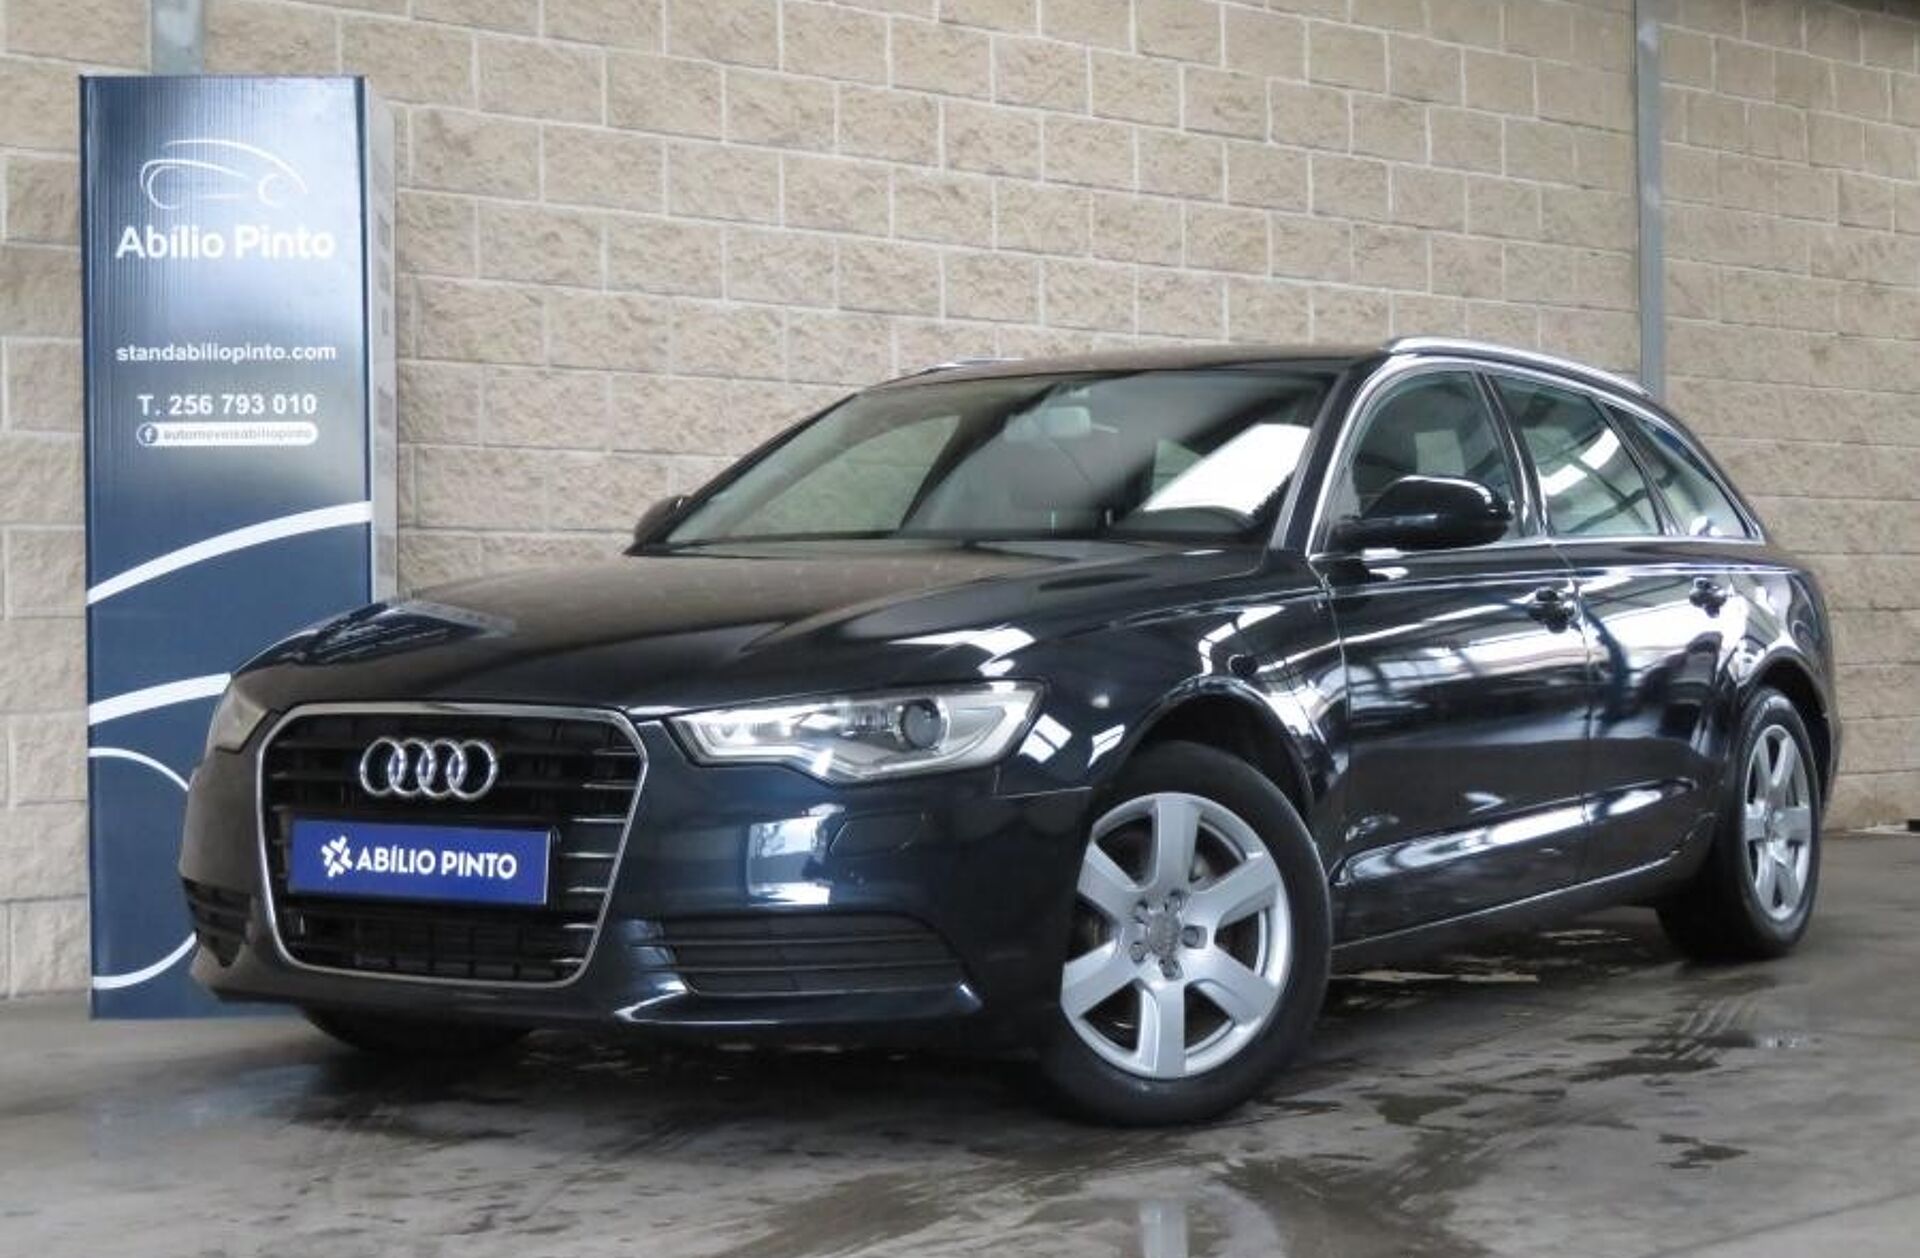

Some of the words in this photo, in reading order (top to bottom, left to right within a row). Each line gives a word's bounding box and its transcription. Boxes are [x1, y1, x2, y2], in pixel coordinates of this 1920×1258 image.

[233, 225, 336, 260] Pinto
[116, 342, 336, 364] standabiliopinto.com
[137, 394, 162, 416] T.
[169, 394, 213, 415] 256
[221, 393, 265, 415] 793
[272, 393, 318, 415] 010
[355, 844, 436, 876] ABÍLIO
[440, 850, 517, 880] PINTO
